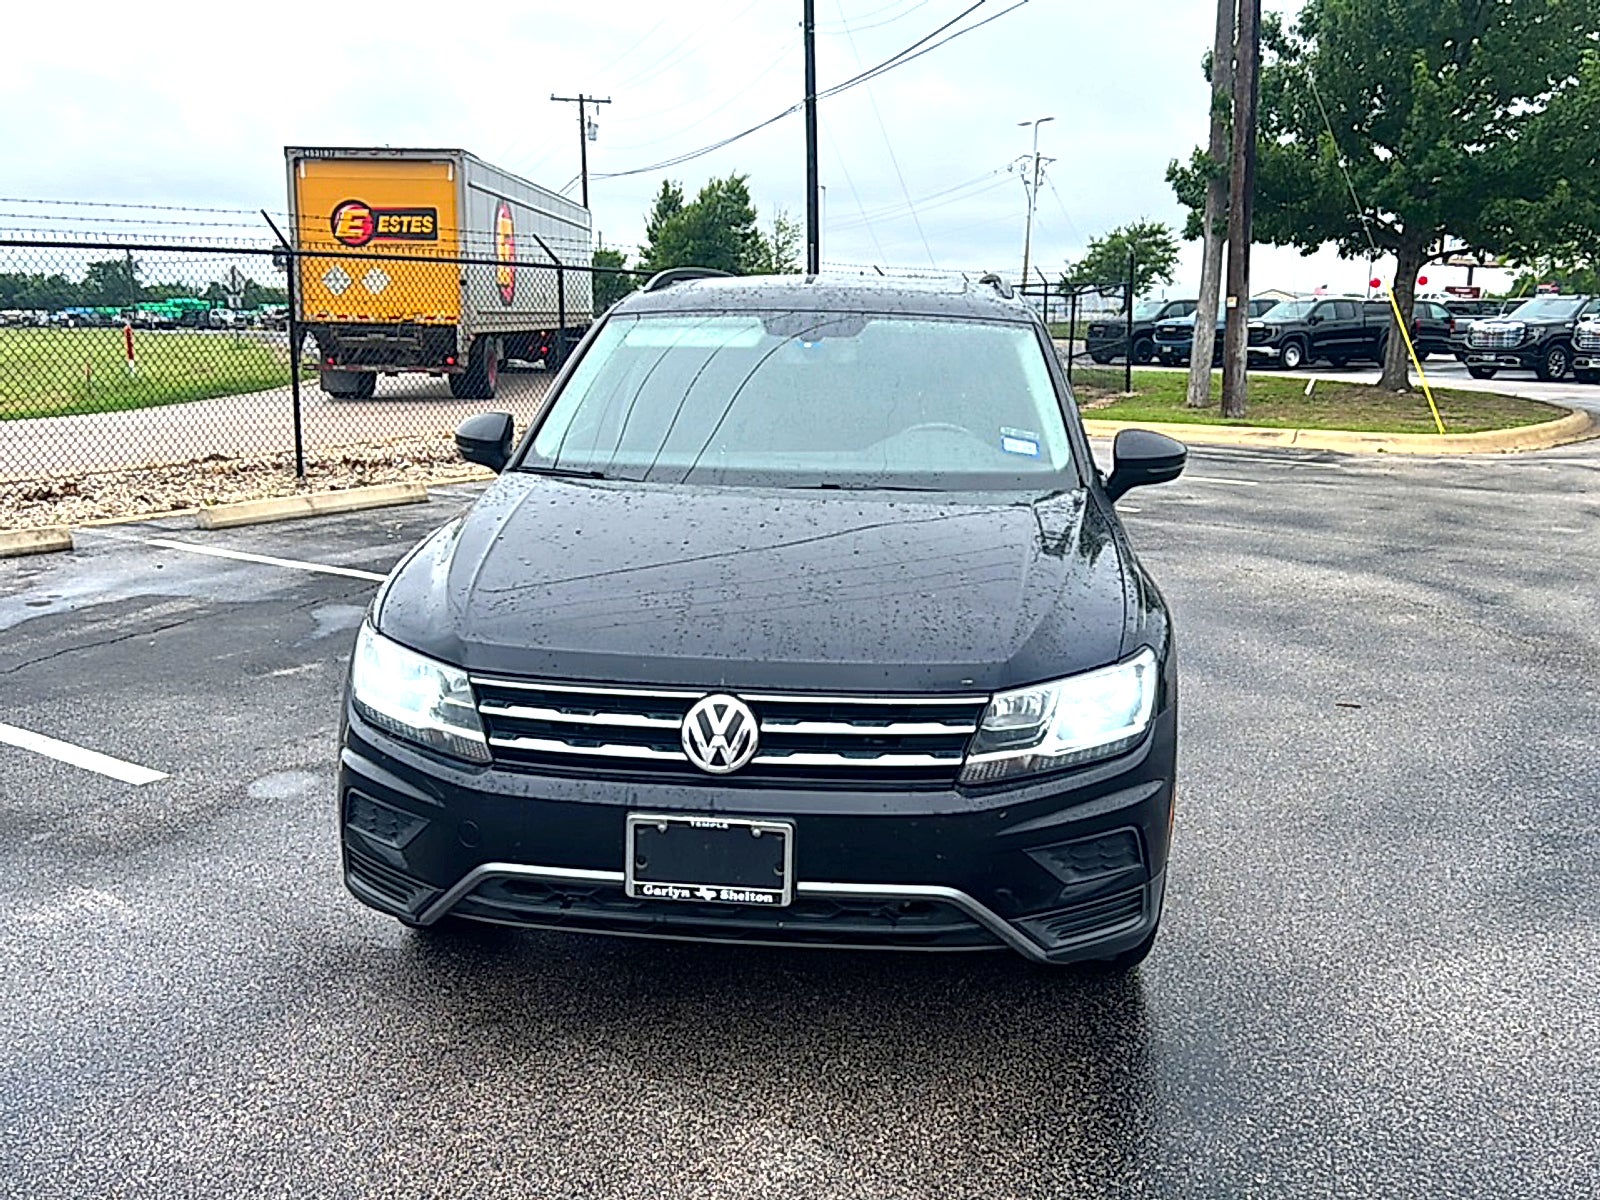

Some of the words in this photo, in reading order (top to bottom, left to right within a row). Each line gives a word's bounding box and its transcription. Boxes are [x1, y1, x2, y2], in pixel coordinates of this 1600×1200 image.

[377, 215, 434, 233] ESTES
[642, 884, 691, 900] Garlyn
[719, 888, 774, 903] Shelton
